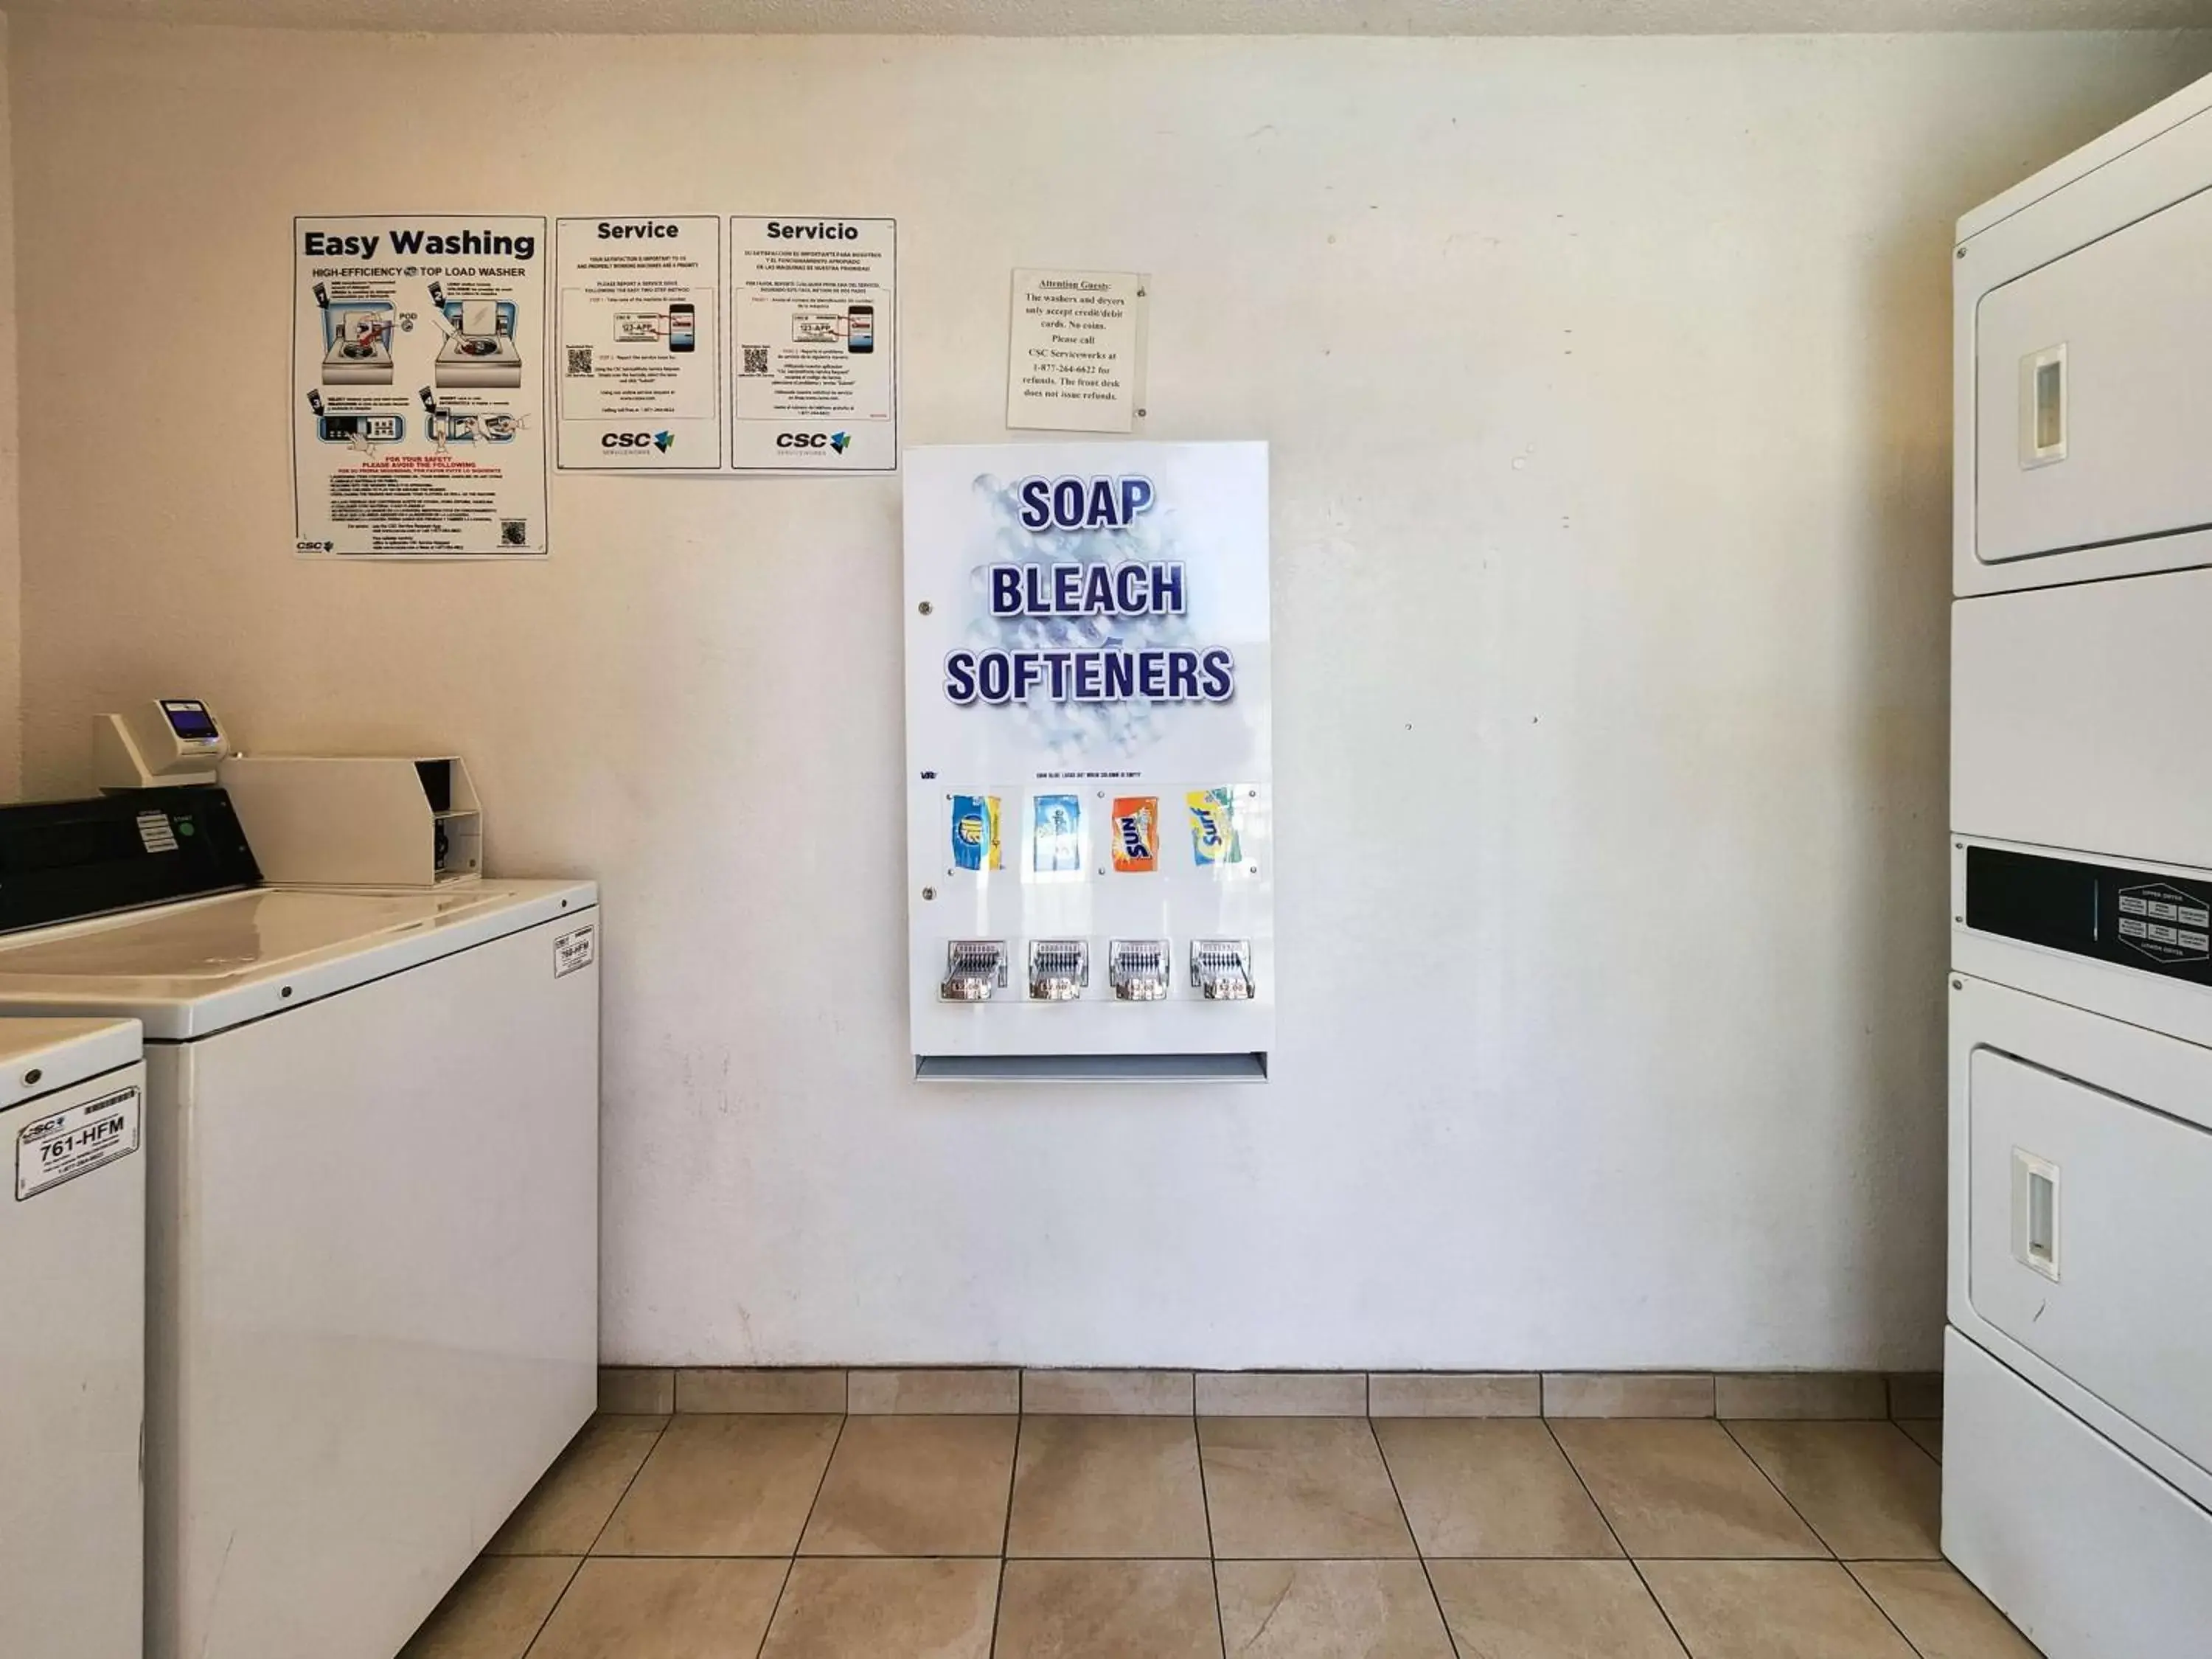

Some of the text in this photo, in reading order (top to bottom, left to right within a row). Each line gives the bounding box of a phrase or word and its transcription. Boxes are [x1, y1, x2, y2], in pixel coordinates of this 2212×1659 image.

[597, 221, 679, 239] Service
[767, 222, 858, 240] Servicio
[305, 230, 535, 260] Easy Washing
[312, 267, 526, 278] HIGH-EFFICIENCY TOP LOAD WASHER
[1039, 279, 1111, 292] Attention Guests:
[434, 291, 442, 301] 2
[1026, 293, 1125, 307] The washers and dryers
[399, 313, 418, 321] POD
[1026, 306, 1123, 319] only accept credit/debit
[1040, 320, 1107, 330] cards. No coins.
[1051, 334, 1095, 344] Please call
[1029, 348, 1049, 357] CSC
[1050, 349, 1106, 361] Serviceworks
[1097, 366, 1110, 375] for
[1023, 376, 1121, 388] refunds. The front desk
[1023, 389, 1043, 398] does
[1060, 392, 1081, 400] issue
[1082, 392, 1118, 401] refunds.
[601, 433, 651, 448] CSC
[776, 433, 827, 448] CSC
[1020, 476, 1154, 529] SOAP
[990, 563, 1185, 615] BLEACH
[945, 648, 1236, 703] SOFTENERS
[1189, 805, 1222, 847] Surf
[1120, 817, 1151, 858] SUN
[40, 1116, 125, 1162] 761-HFM
